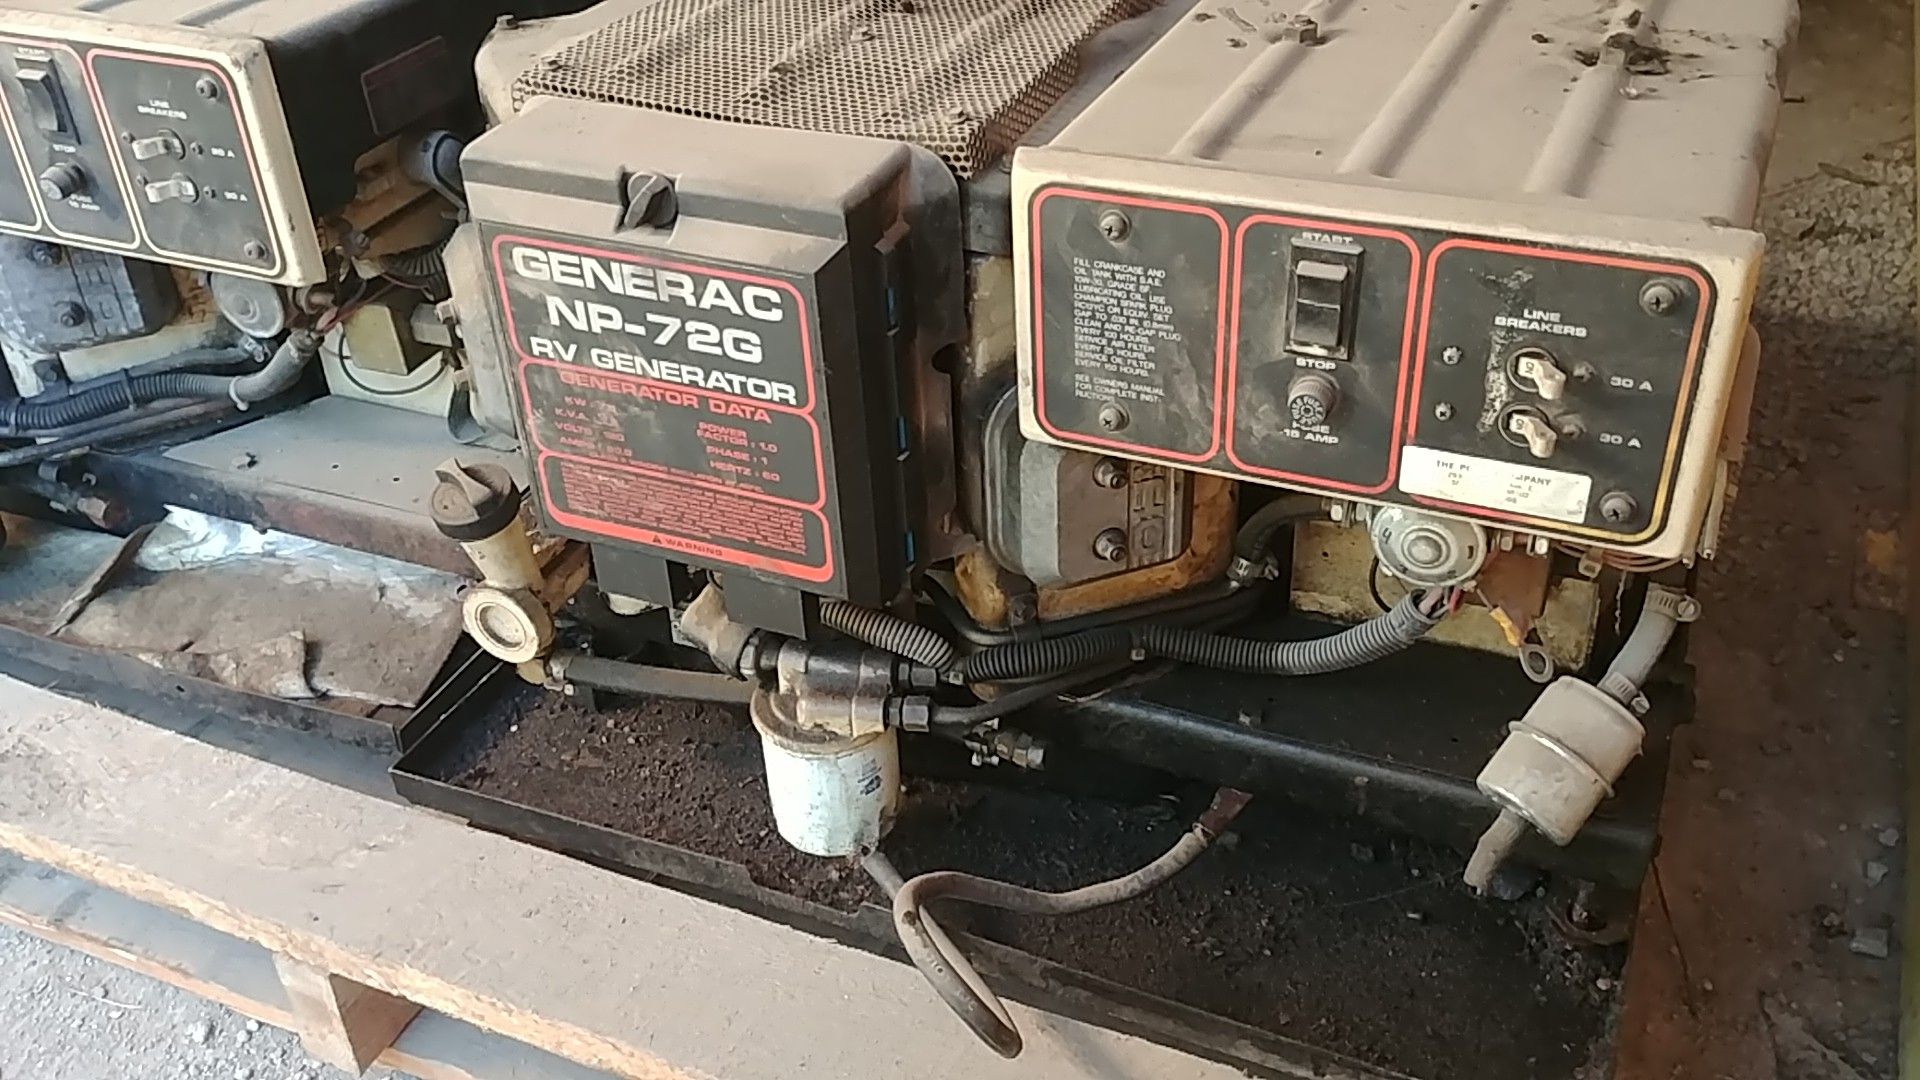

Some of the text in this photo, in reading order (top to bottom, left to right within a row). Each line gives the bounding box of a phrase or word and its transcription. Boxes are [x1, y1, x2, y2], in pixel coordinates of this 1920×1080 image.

[1301, 231, 1354, 245] START
[1074, 257, 1090, 268] FILL
[1147, 268, 1166, 279] AND
[511, 245, 784, 322] GENERAC
[1074, 308, 1093, 318] GAP
[1094, 312, 1107, 321] TO
[1149, 303, 1173, 315] PLUG
[1523, 308, 1561, 323] LINE
[545, 294, 763, 364] NP-72G
[1074, 317, 1102, 328] CLEAN
[1103, 322, 1122, 331] AND
[1158, 330, 1181, 341] PLUG
[1493, 315, 1588, 338] BREAKERS
[529, 335, 798, 405] RV GENERATOR
[1296, 357, 1337, 371] STOP
[1610, 375, 1654, 392] 30 A
[559, 371, 699, 409] GENERATOR
[707, 398, 772, 424] DATA
[696, 429, 748, 447] FACTOR
[698, 421, 747, 438] POWER
[1304, 432, 1339, 444] AMP
[1599, 432, 1642, 449] 30 A
[706, 445, 750, 461] PHASE
[709, 460, 752, 476] HERTZ
[665, 538, 723, 556] WARNING
